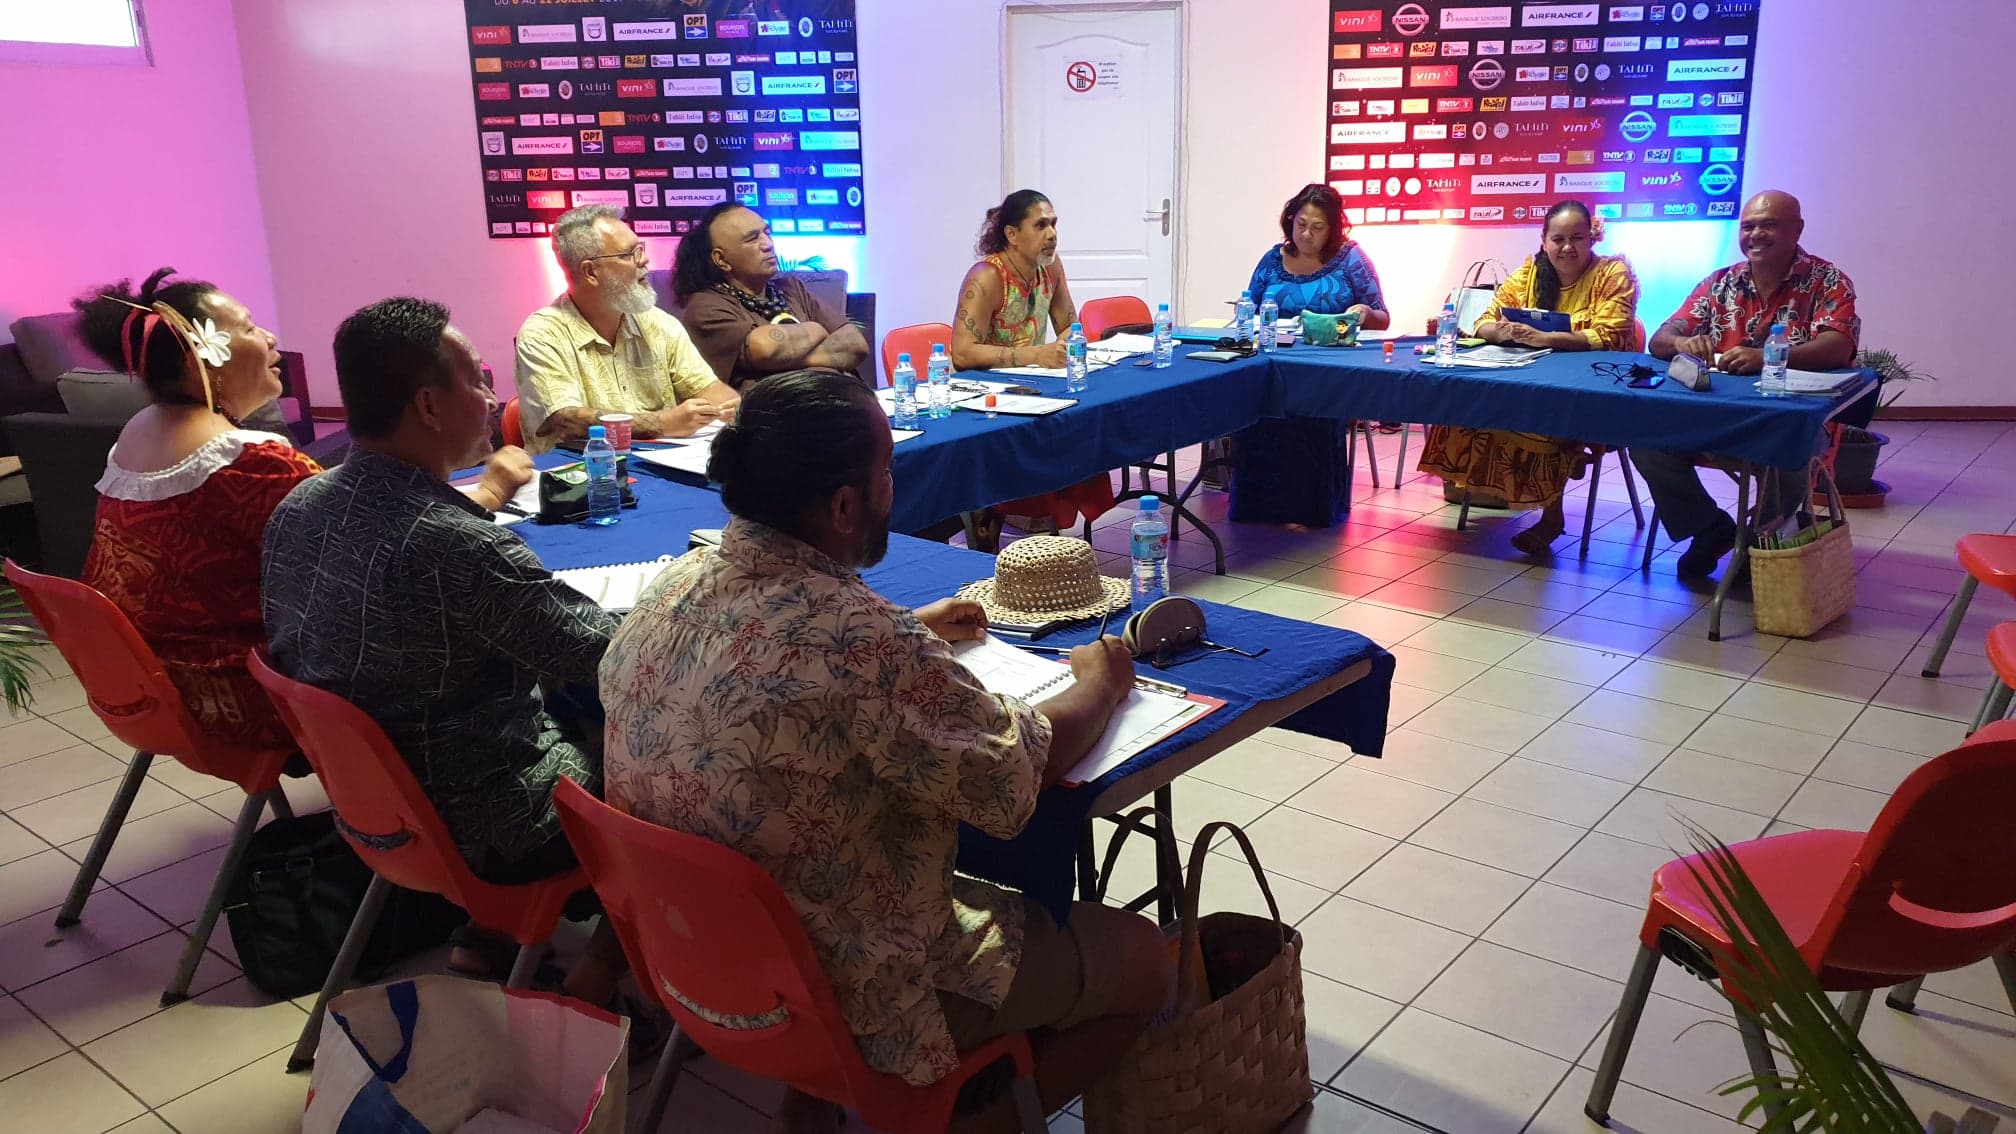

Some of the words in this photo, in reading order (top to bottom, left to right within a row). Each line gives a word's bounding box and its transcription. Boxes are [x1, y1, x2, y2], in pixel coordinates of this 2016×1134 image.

[1528, 12, 1584, 20] AIRFRANCE
[686, 16, 704, 26] OPT
[1673, 66, 1730, 74] AIRFRANCE
[836, 71, 855, 80] OPT
[1473, 71, 1501, 79] NISSAN
[583, 132, 600, 141] OPT
[1703, 175, 1734, 183] NISSAN
[737, 184, 755, 193] OPT
